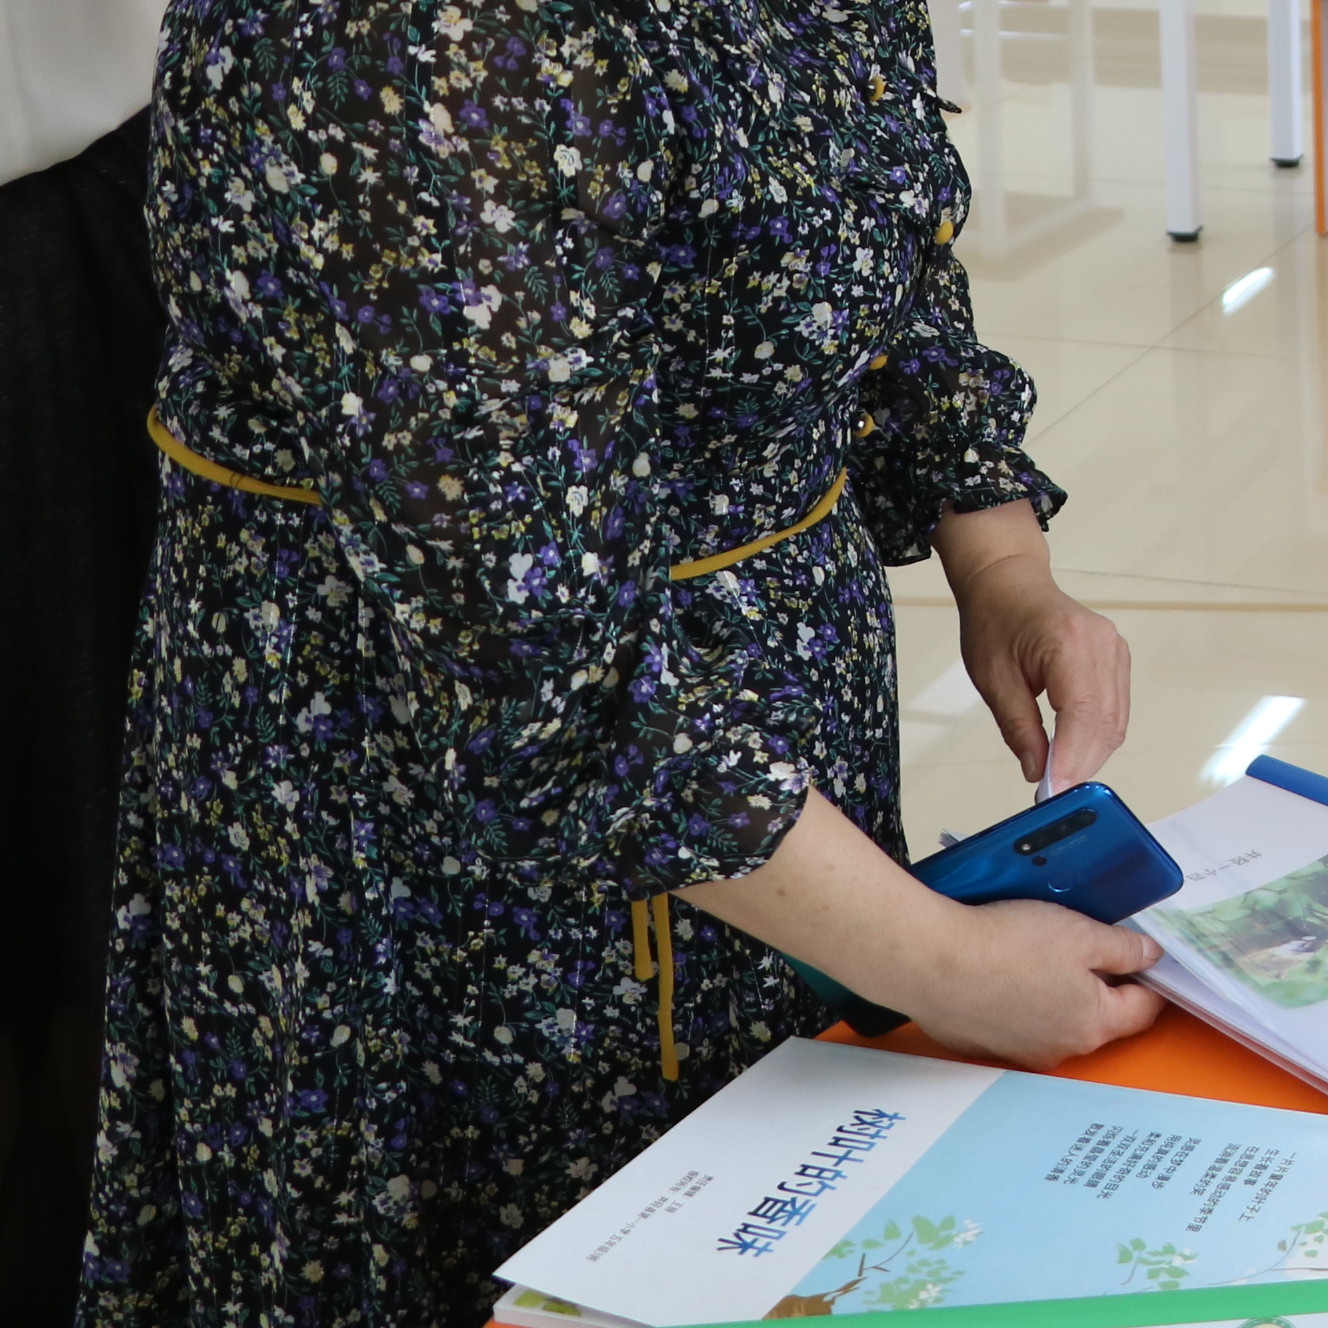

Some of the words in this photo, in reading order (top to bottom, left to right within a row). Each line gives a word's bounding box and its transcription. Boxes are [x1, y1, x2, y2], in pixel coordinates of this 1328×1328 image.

[714, 1105, 905, 1260] 树叶的香味
